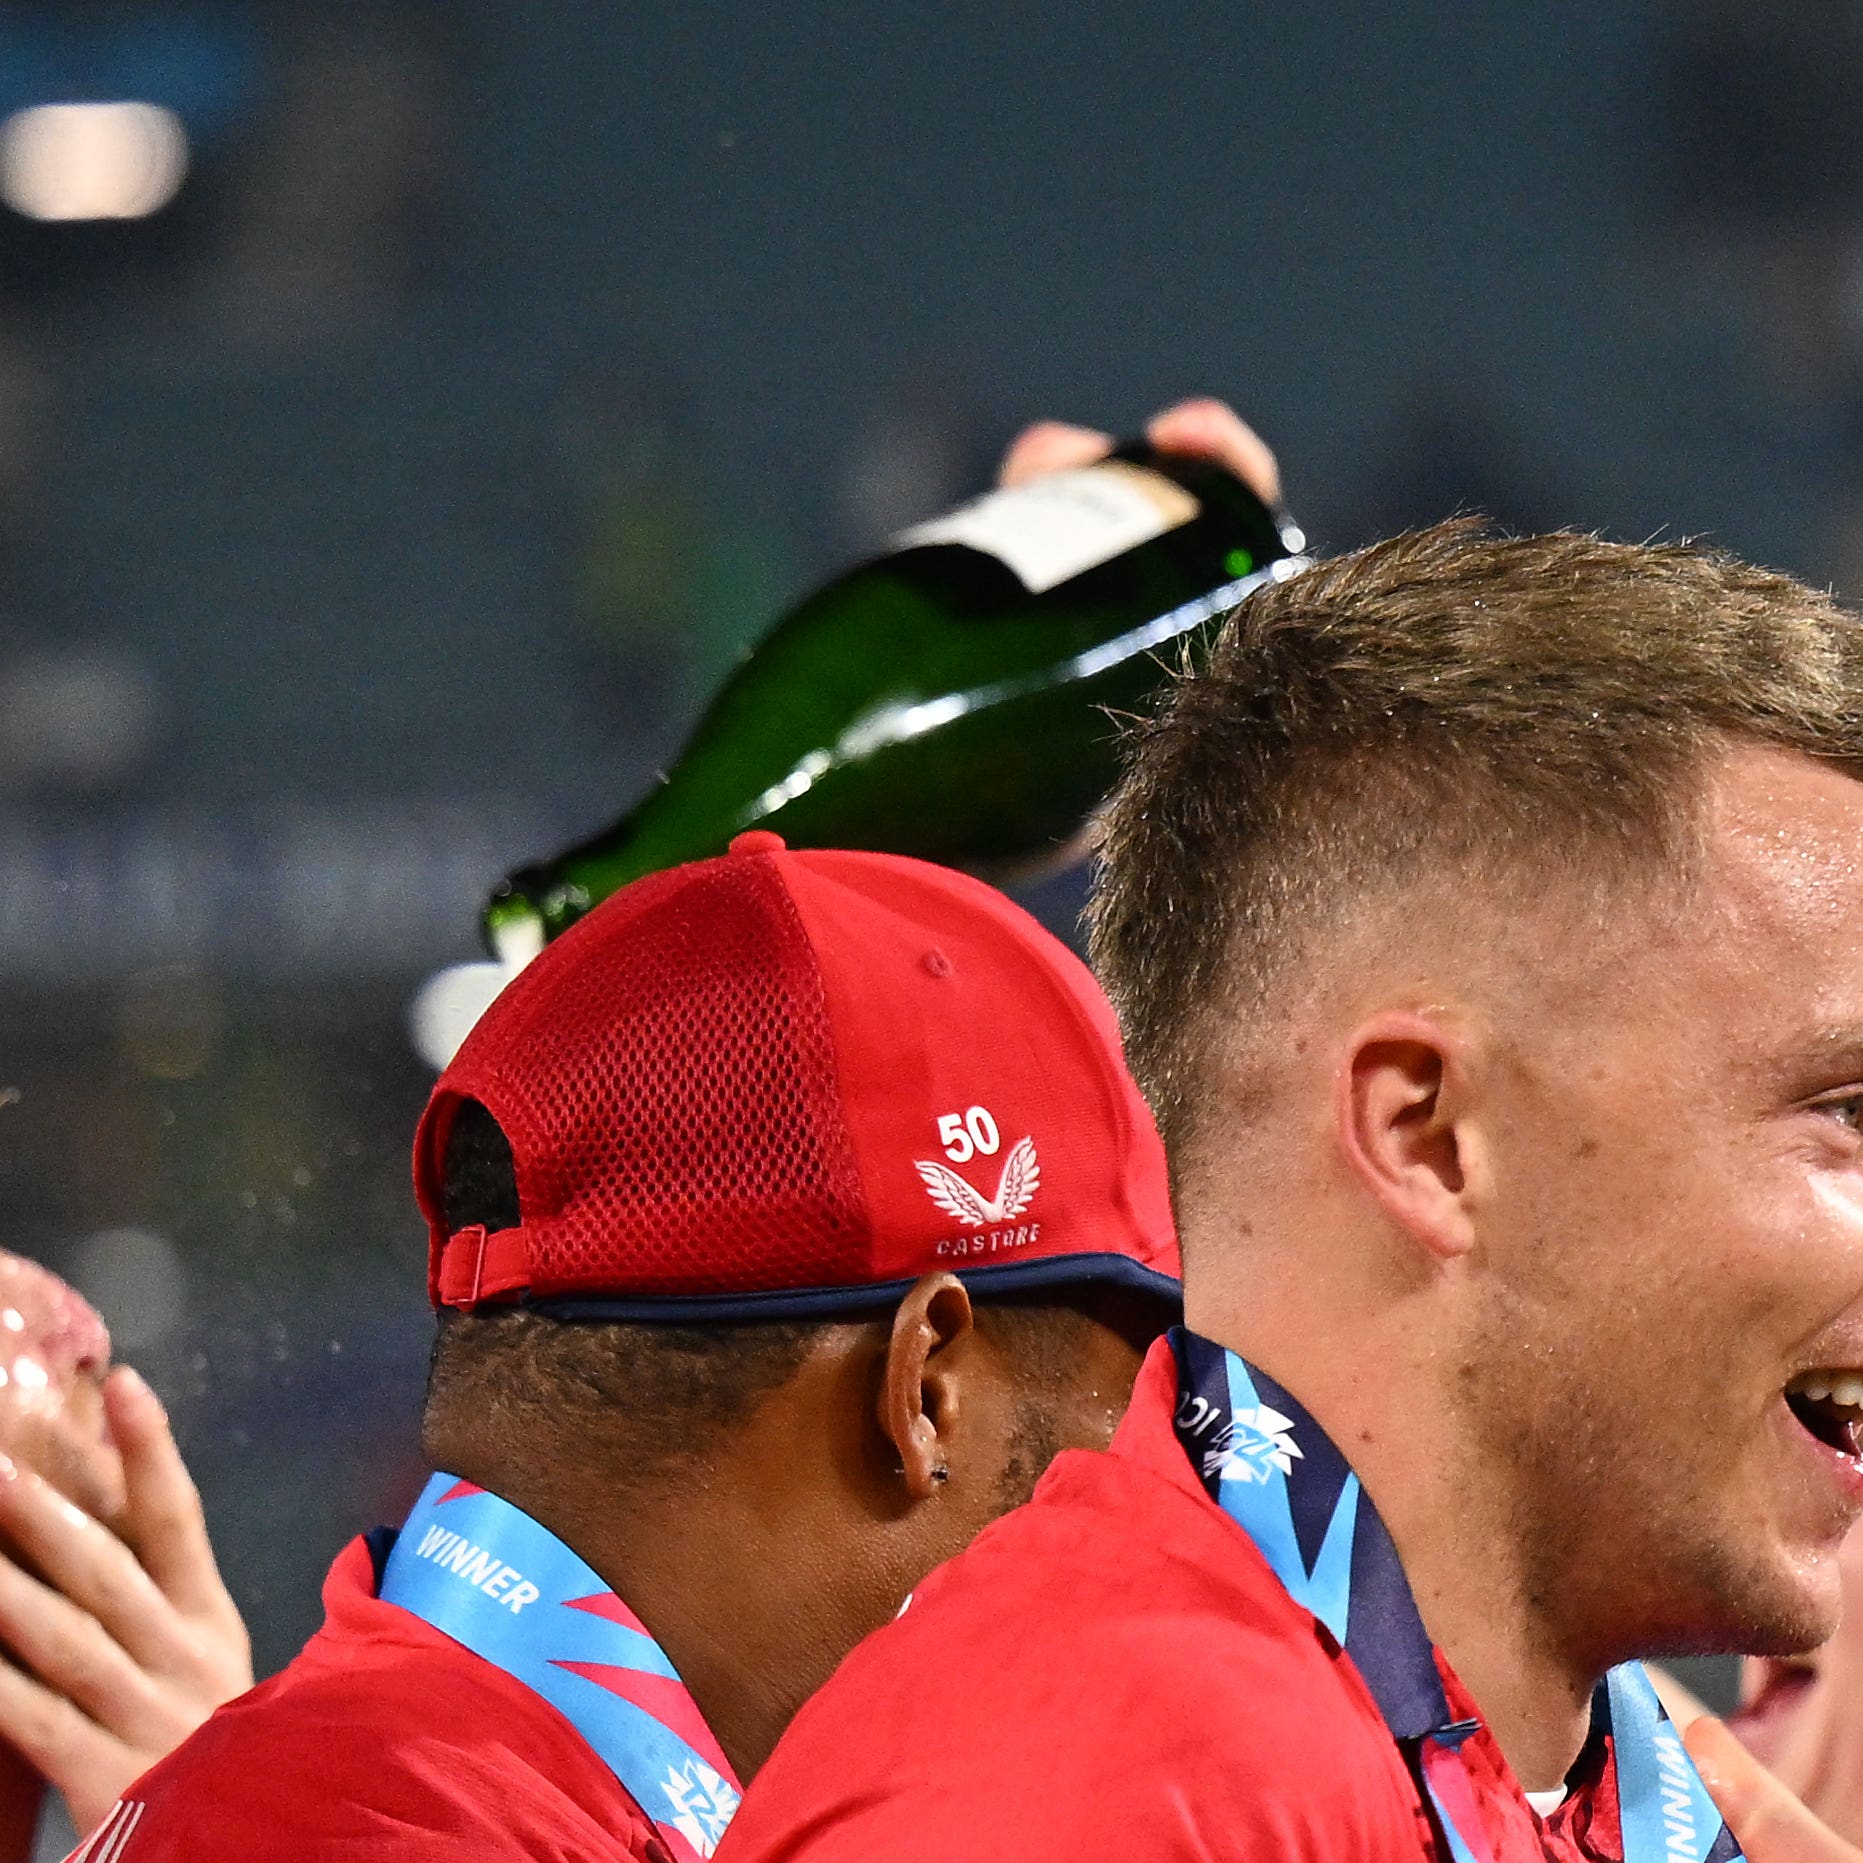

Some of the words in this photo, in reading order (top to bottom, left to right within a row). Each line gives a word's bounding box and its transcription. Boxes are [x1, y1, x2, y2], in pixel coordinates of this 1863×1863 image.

[937, 1106, 1000, 1163] 50
[936, 1223, 1041, 1256] CASTORE
[416, 1524, 540, 1615] WINNER
